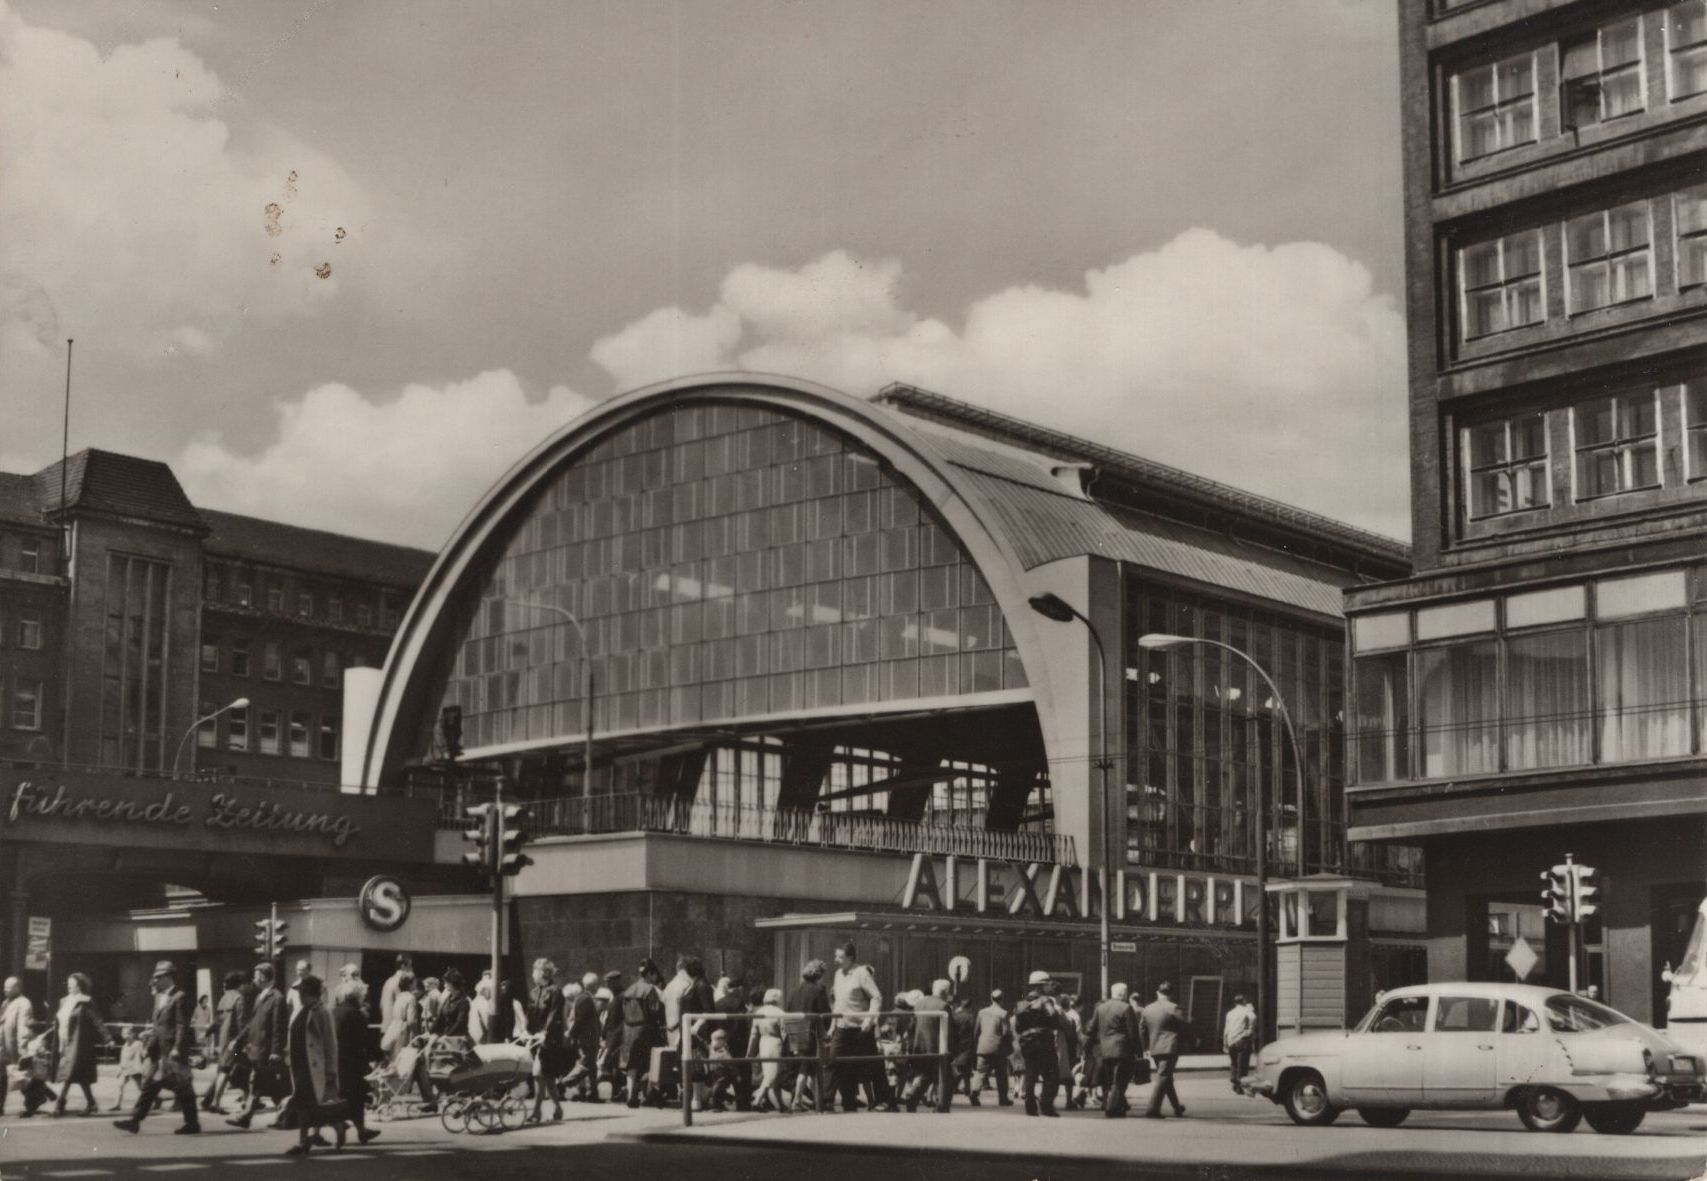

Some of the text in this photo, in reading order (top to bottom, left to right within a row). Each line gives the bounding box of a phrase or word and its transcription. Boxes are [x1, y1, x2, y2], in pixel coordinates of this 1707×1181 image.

[9, 781, 361, 846] führende Zeitung
[369, 881, 401, 925] S
